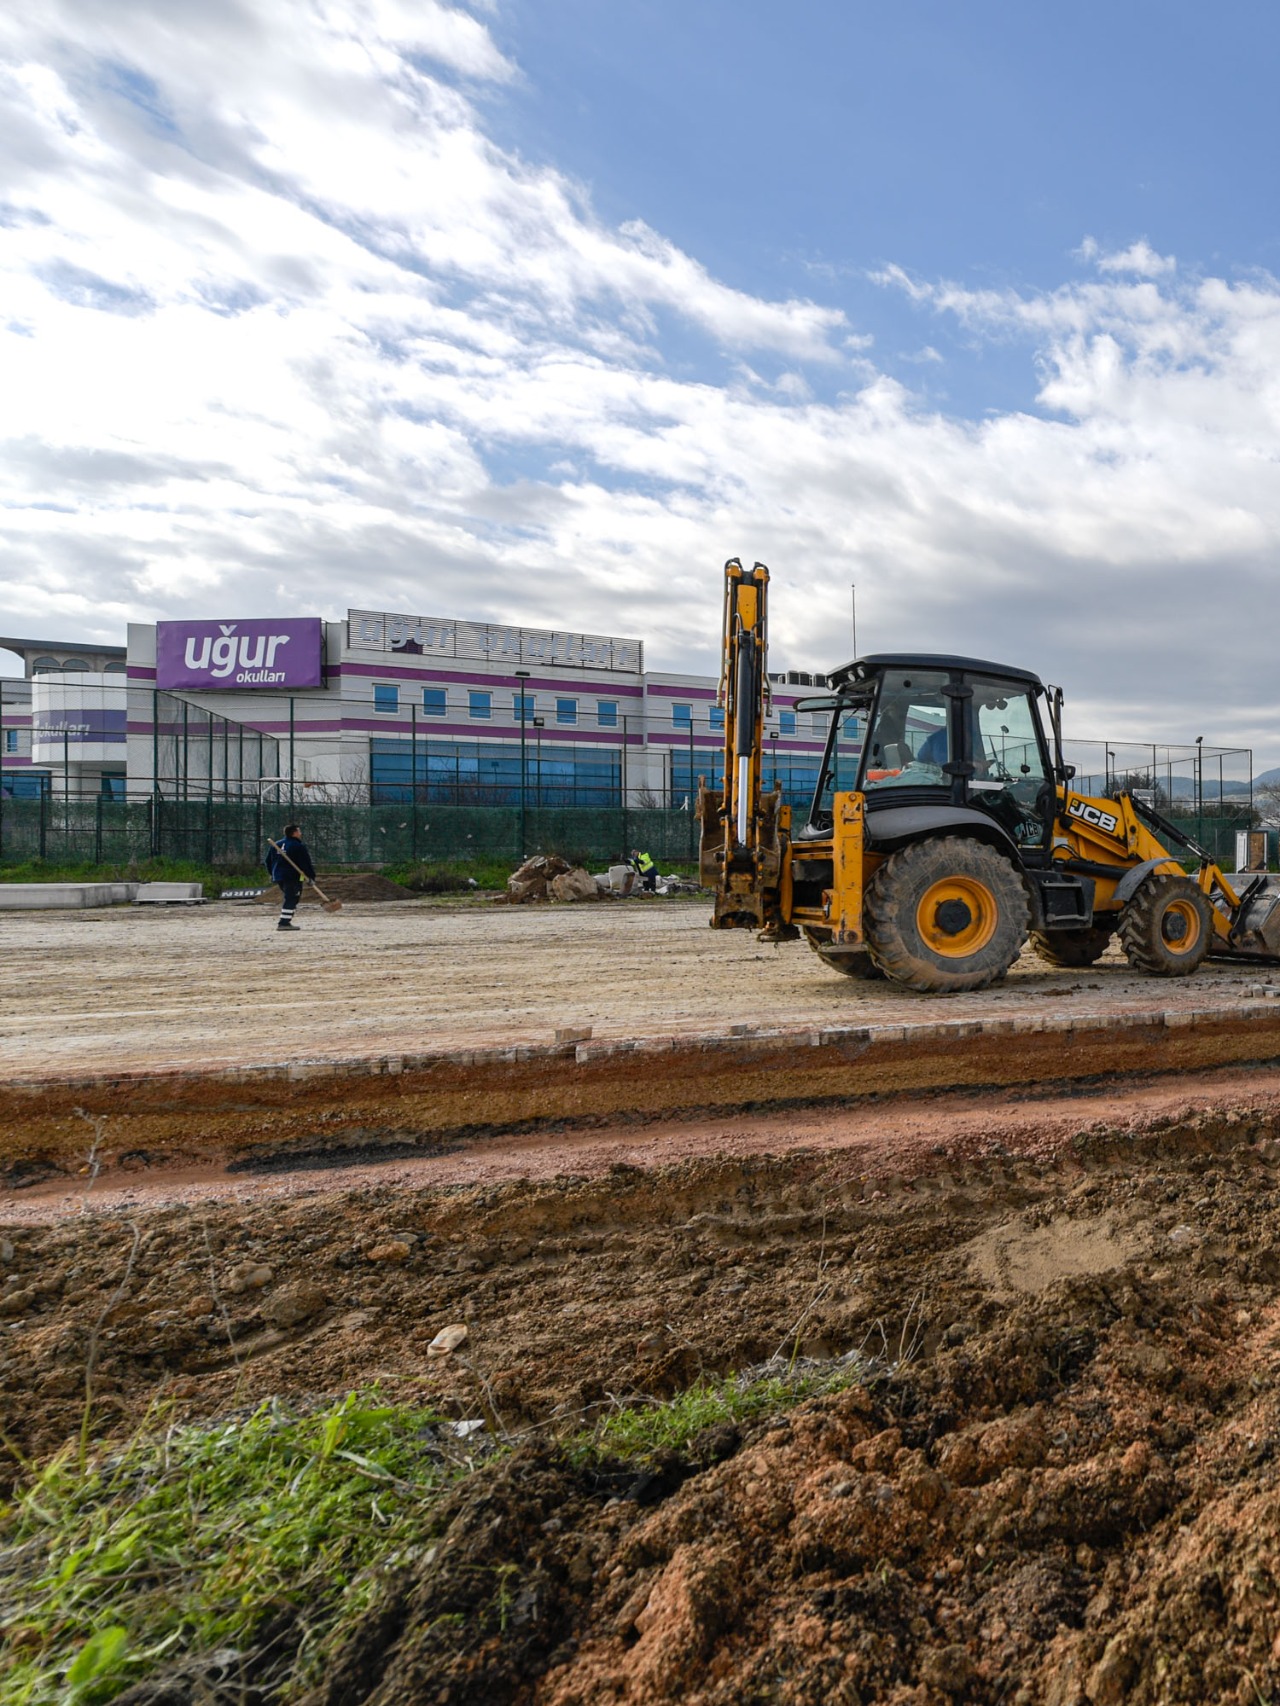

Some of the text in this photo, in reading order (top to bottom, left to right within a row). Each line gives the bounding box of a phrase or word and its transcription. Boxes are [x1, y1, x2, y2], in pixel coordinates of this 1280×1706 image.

[358, 616, 457, 648] uğur
[185, 625, 290, 677] uğur
[236, 670, 286, 683] okulları
[1069, 803, 1116, 832] JCB
